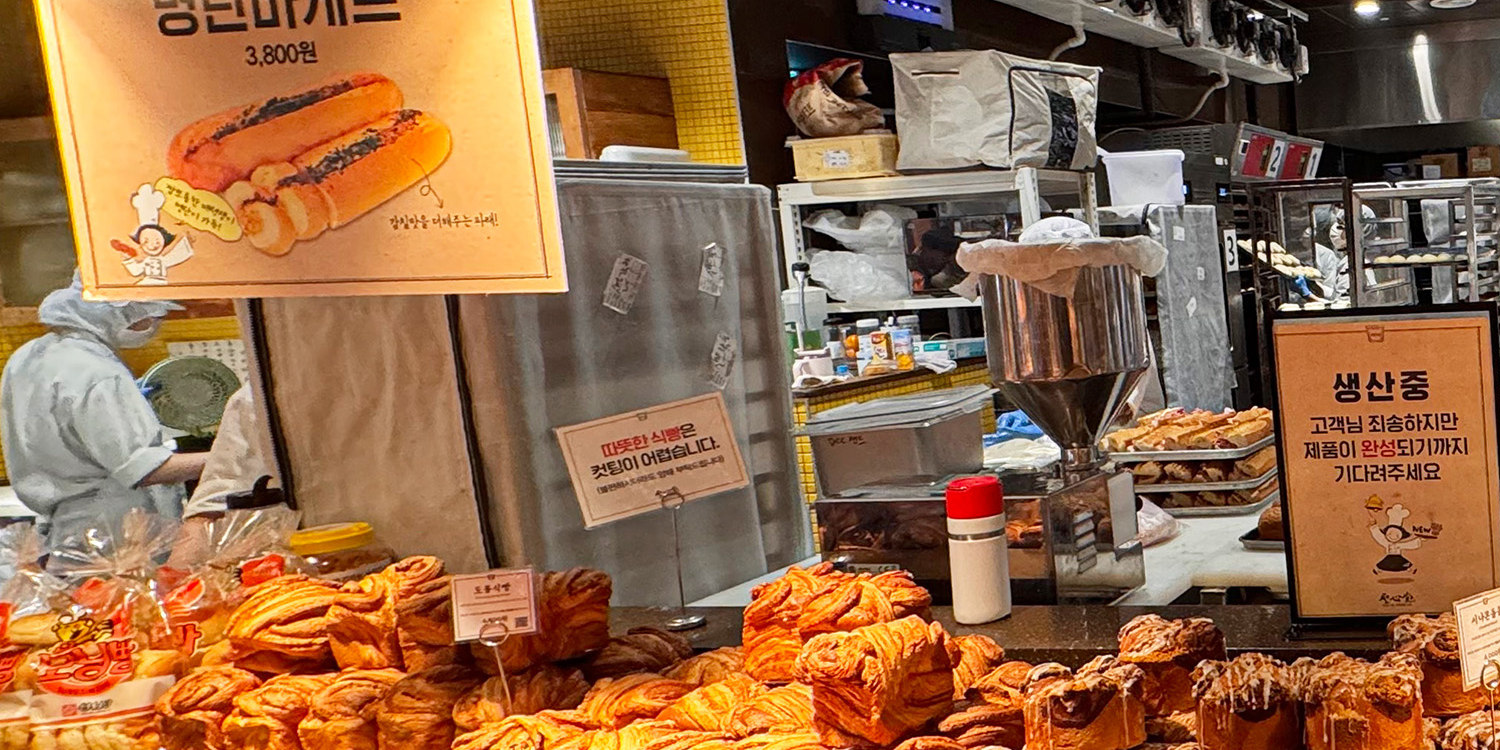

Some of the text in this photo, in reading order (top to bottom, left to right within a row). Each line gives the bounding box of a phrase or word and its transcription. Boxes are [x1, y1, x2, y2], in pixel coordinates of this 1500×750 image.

[245, 41, 318, 67] 3,800원
[1270, 146, 1281, 172] 2
[1309, 153, 1317, 177] 1
[1226, 235, 1236, 266] 3
[1333, 370, 1430, 403] 생산중
[1310, 412, 1459, 434] 고객님 죄송하지만
[601, 423, 697, 458] 따뜻한 식빵은
[1304, 437, 1469, 459] 제품이 완성되기까지
[590, 436, 720, 480] 컷팅이 어렵습니다.
[1334, 462, 1442, 483] 기다려주세요
[1412, 525, 1431, 534] NEW
